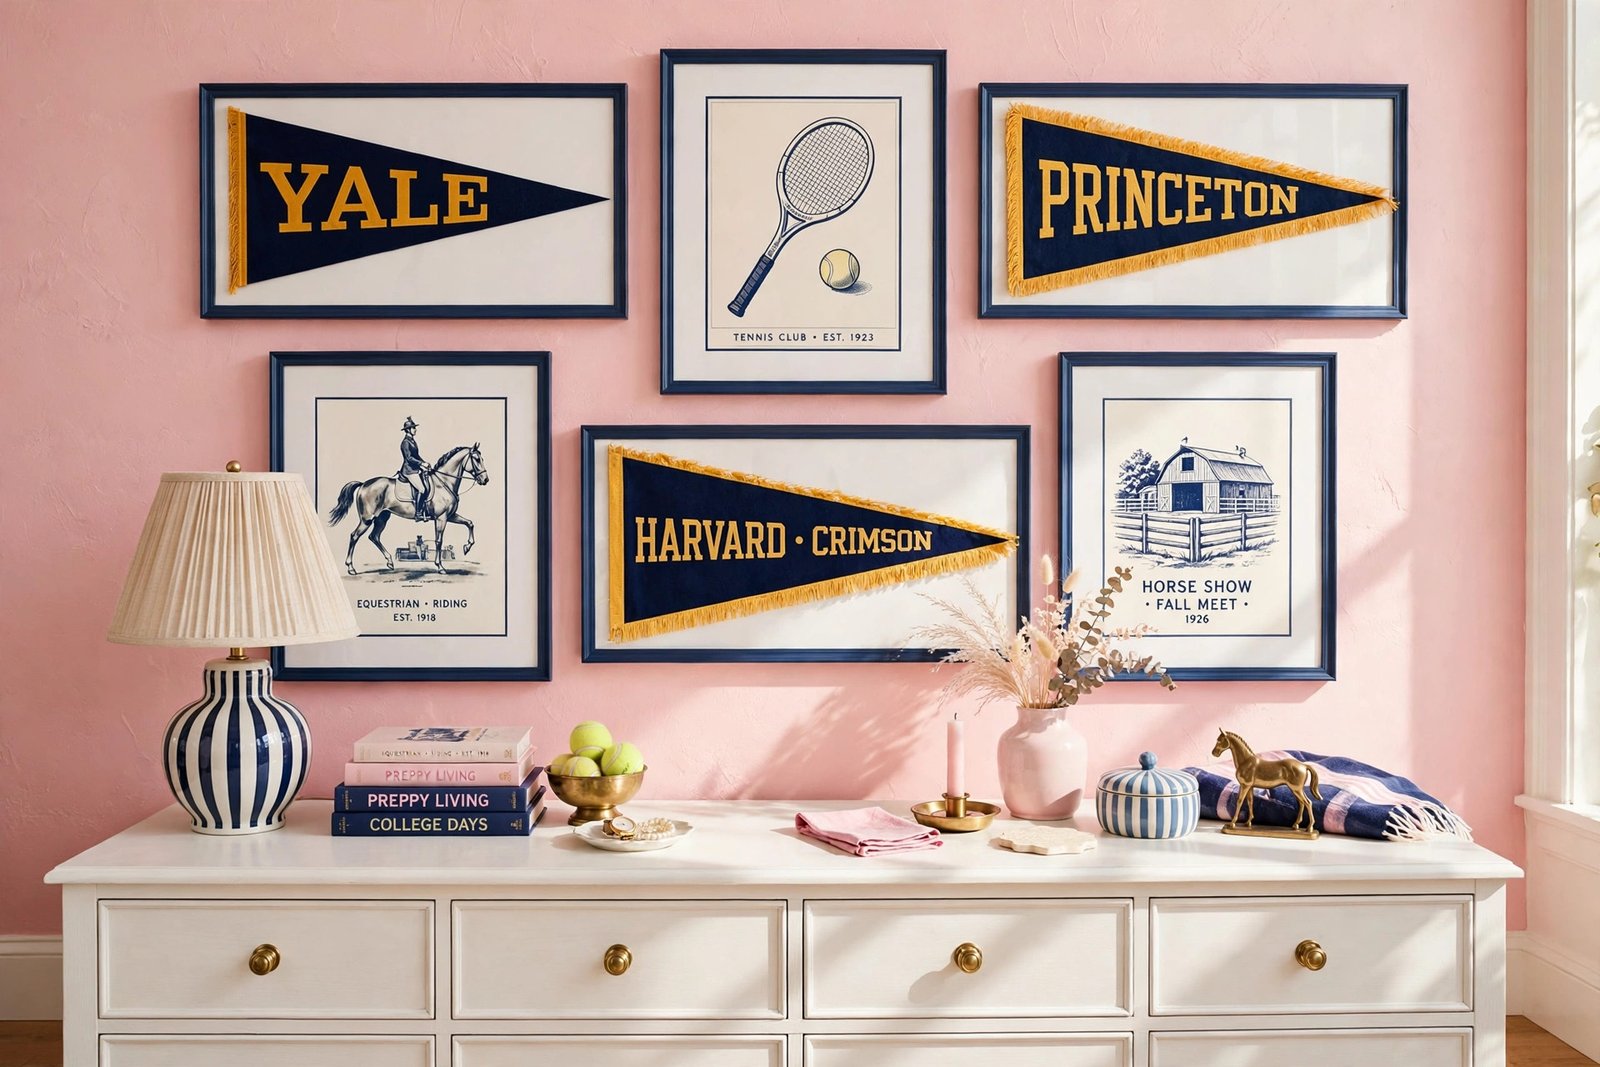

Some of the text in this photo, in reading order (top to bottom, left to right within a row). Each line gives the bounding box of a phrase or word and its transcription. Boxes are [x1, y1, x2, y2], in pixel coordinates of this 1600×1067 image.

[259, 161, 488, 233] YALE
[1038, 158, 1300, 239] PRINCETON
[733, 333, 874, 342] TENNIS CLUB EST. 1923
[635, 516, 933, 563] HARVARD CRIMSON
[1142, 580, 1252, 593] HORSE SHOW
[357, 599, 468, 609] EQUESTRIAN RIDING
[1156, 599, 1237, 610] FALL MEET
[393, 613, 436, 622] EST. 1918
[1185, 614, 1209, 624] 1926
[385, 770, 476, 781] PREPPY LIVING
[368, 794, 430, 808] PREPPY
[435, 794, 489, 808] LIVING
[369, 817, 488, 831] COLLEGE DAYS
